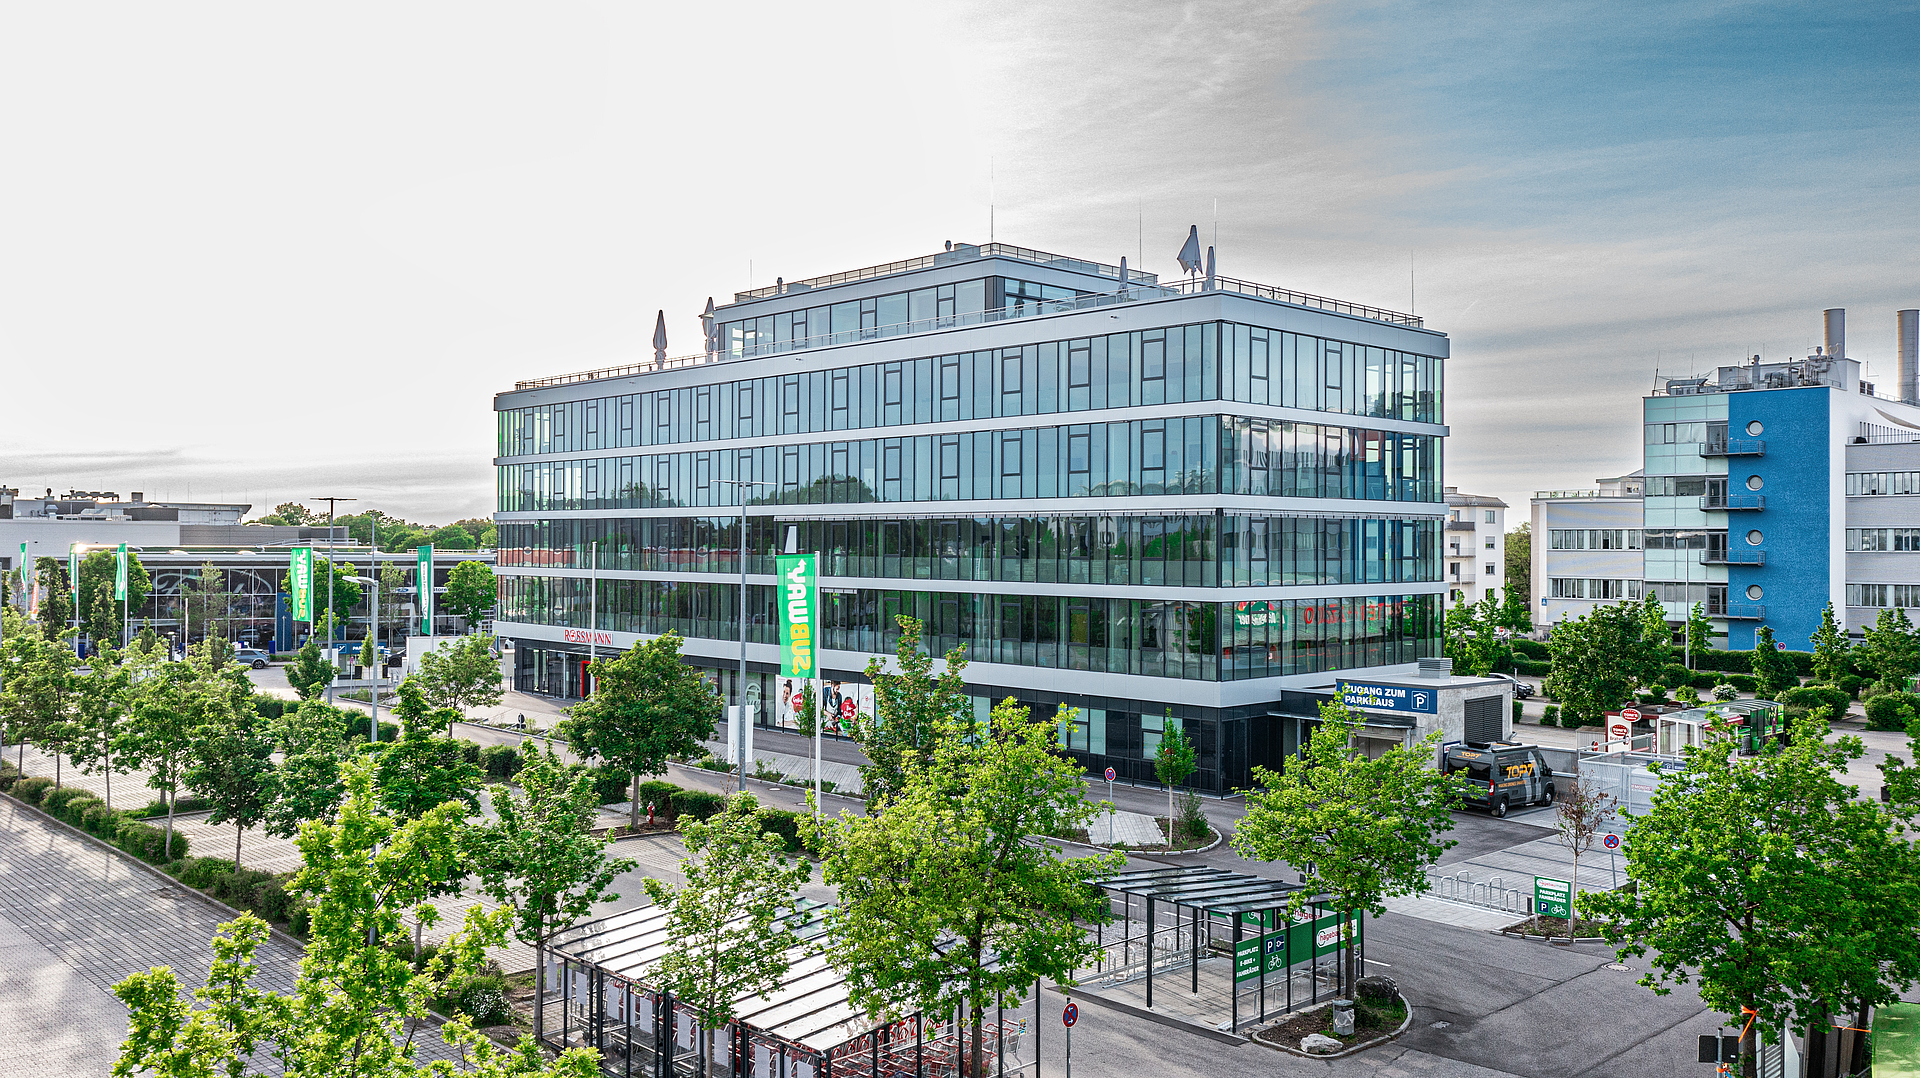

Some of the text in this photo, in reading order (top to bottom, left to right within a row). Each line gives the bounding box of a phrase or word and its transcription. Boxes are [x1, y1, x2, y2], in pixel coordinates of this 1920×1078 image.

[565, 629, 612, 645] ROSSMANN
[1344, 685, 1406, 698] ZUGANG ZUM
[1539, 889, 1565, 898] PARKPLATZ
[1539, 894, 1566, 903] FAHRRÄDER
[1541, 902, 1547, 911] P
[1237, 945, 1259, 958] PARKPLATZ
[1267, 941, 1273, 952] P
[1237, 965, 1259, 978] FAHRRÄDER
